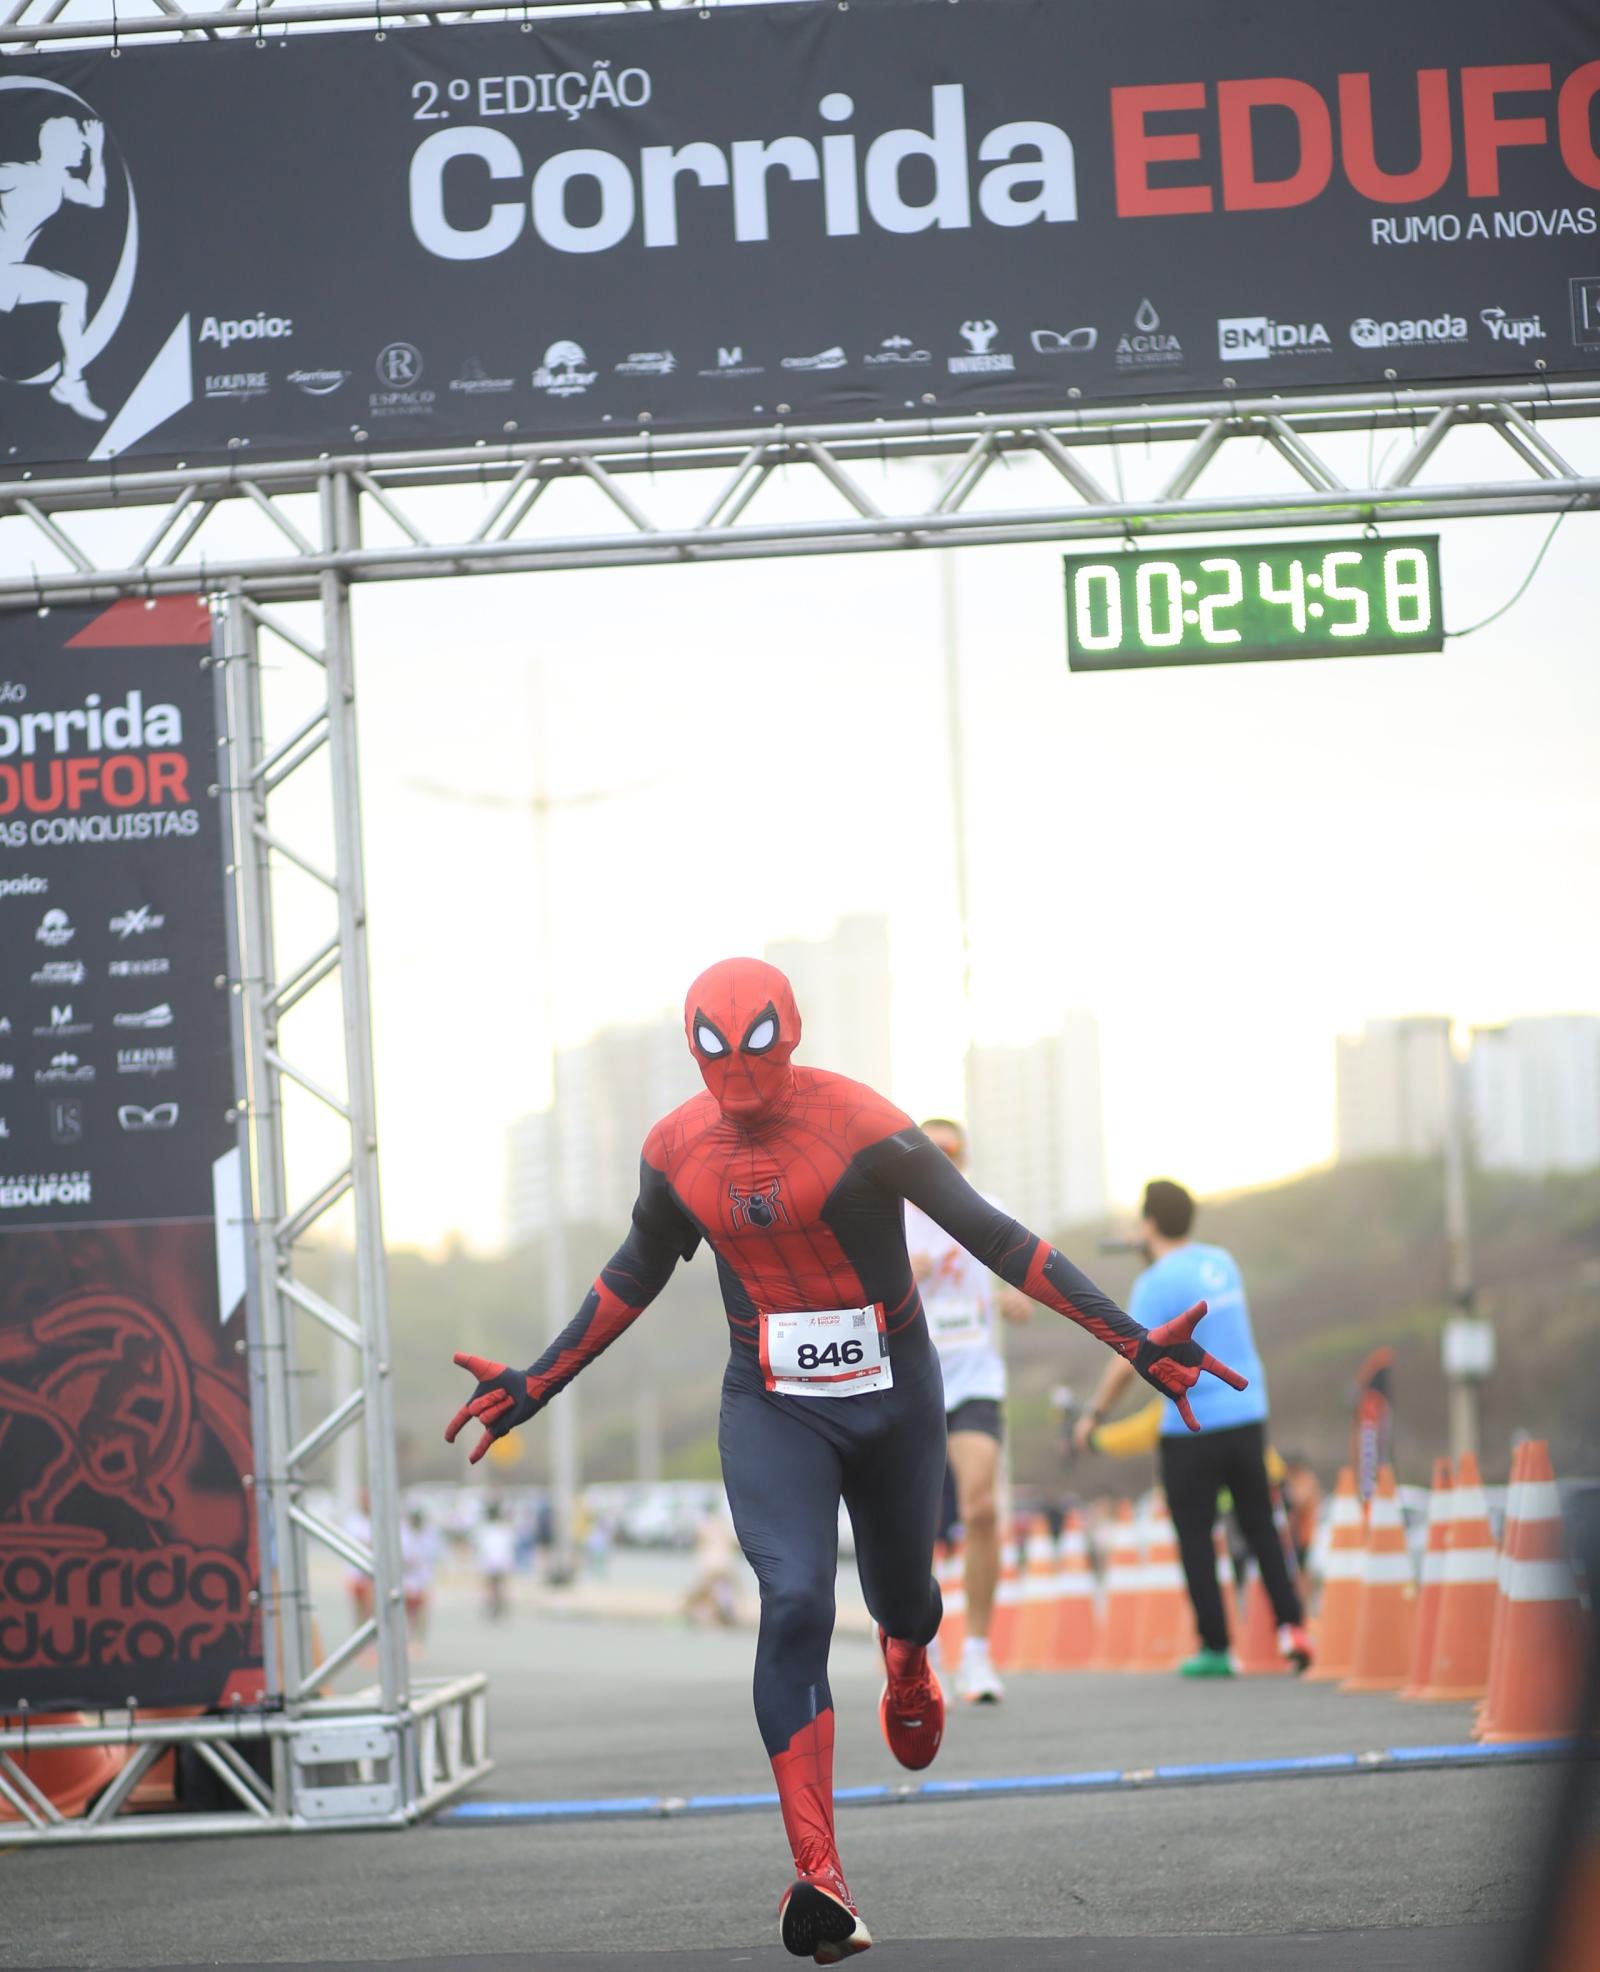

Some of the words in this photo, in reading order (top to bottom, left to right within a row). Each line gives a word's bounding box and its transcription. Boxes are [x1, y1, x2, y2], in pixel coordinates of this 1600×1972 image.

[478, 60, 652, 121] EDIÇÃO
[408, 83, 1078, 261] Corrida
[1371, 214, 1461, 245] RUMO
[1466, 213, 1489, 240] A
[1494, 207, 1597, 238] NOVAS
[199, 312, 293, 349] Apoio:
[1381, 314, 1468, 347] panda
[1075, 548, 1432, 650] 00:24:58
[0, 681, 27, 703] ÃO
[30, 809, 199, 846] CONQUISTAS
[0, 1182, 91, 1207] EDUFOR
[797, 1339, 864, 1370] 846
[0, 1555, 241, 1614] orrida
